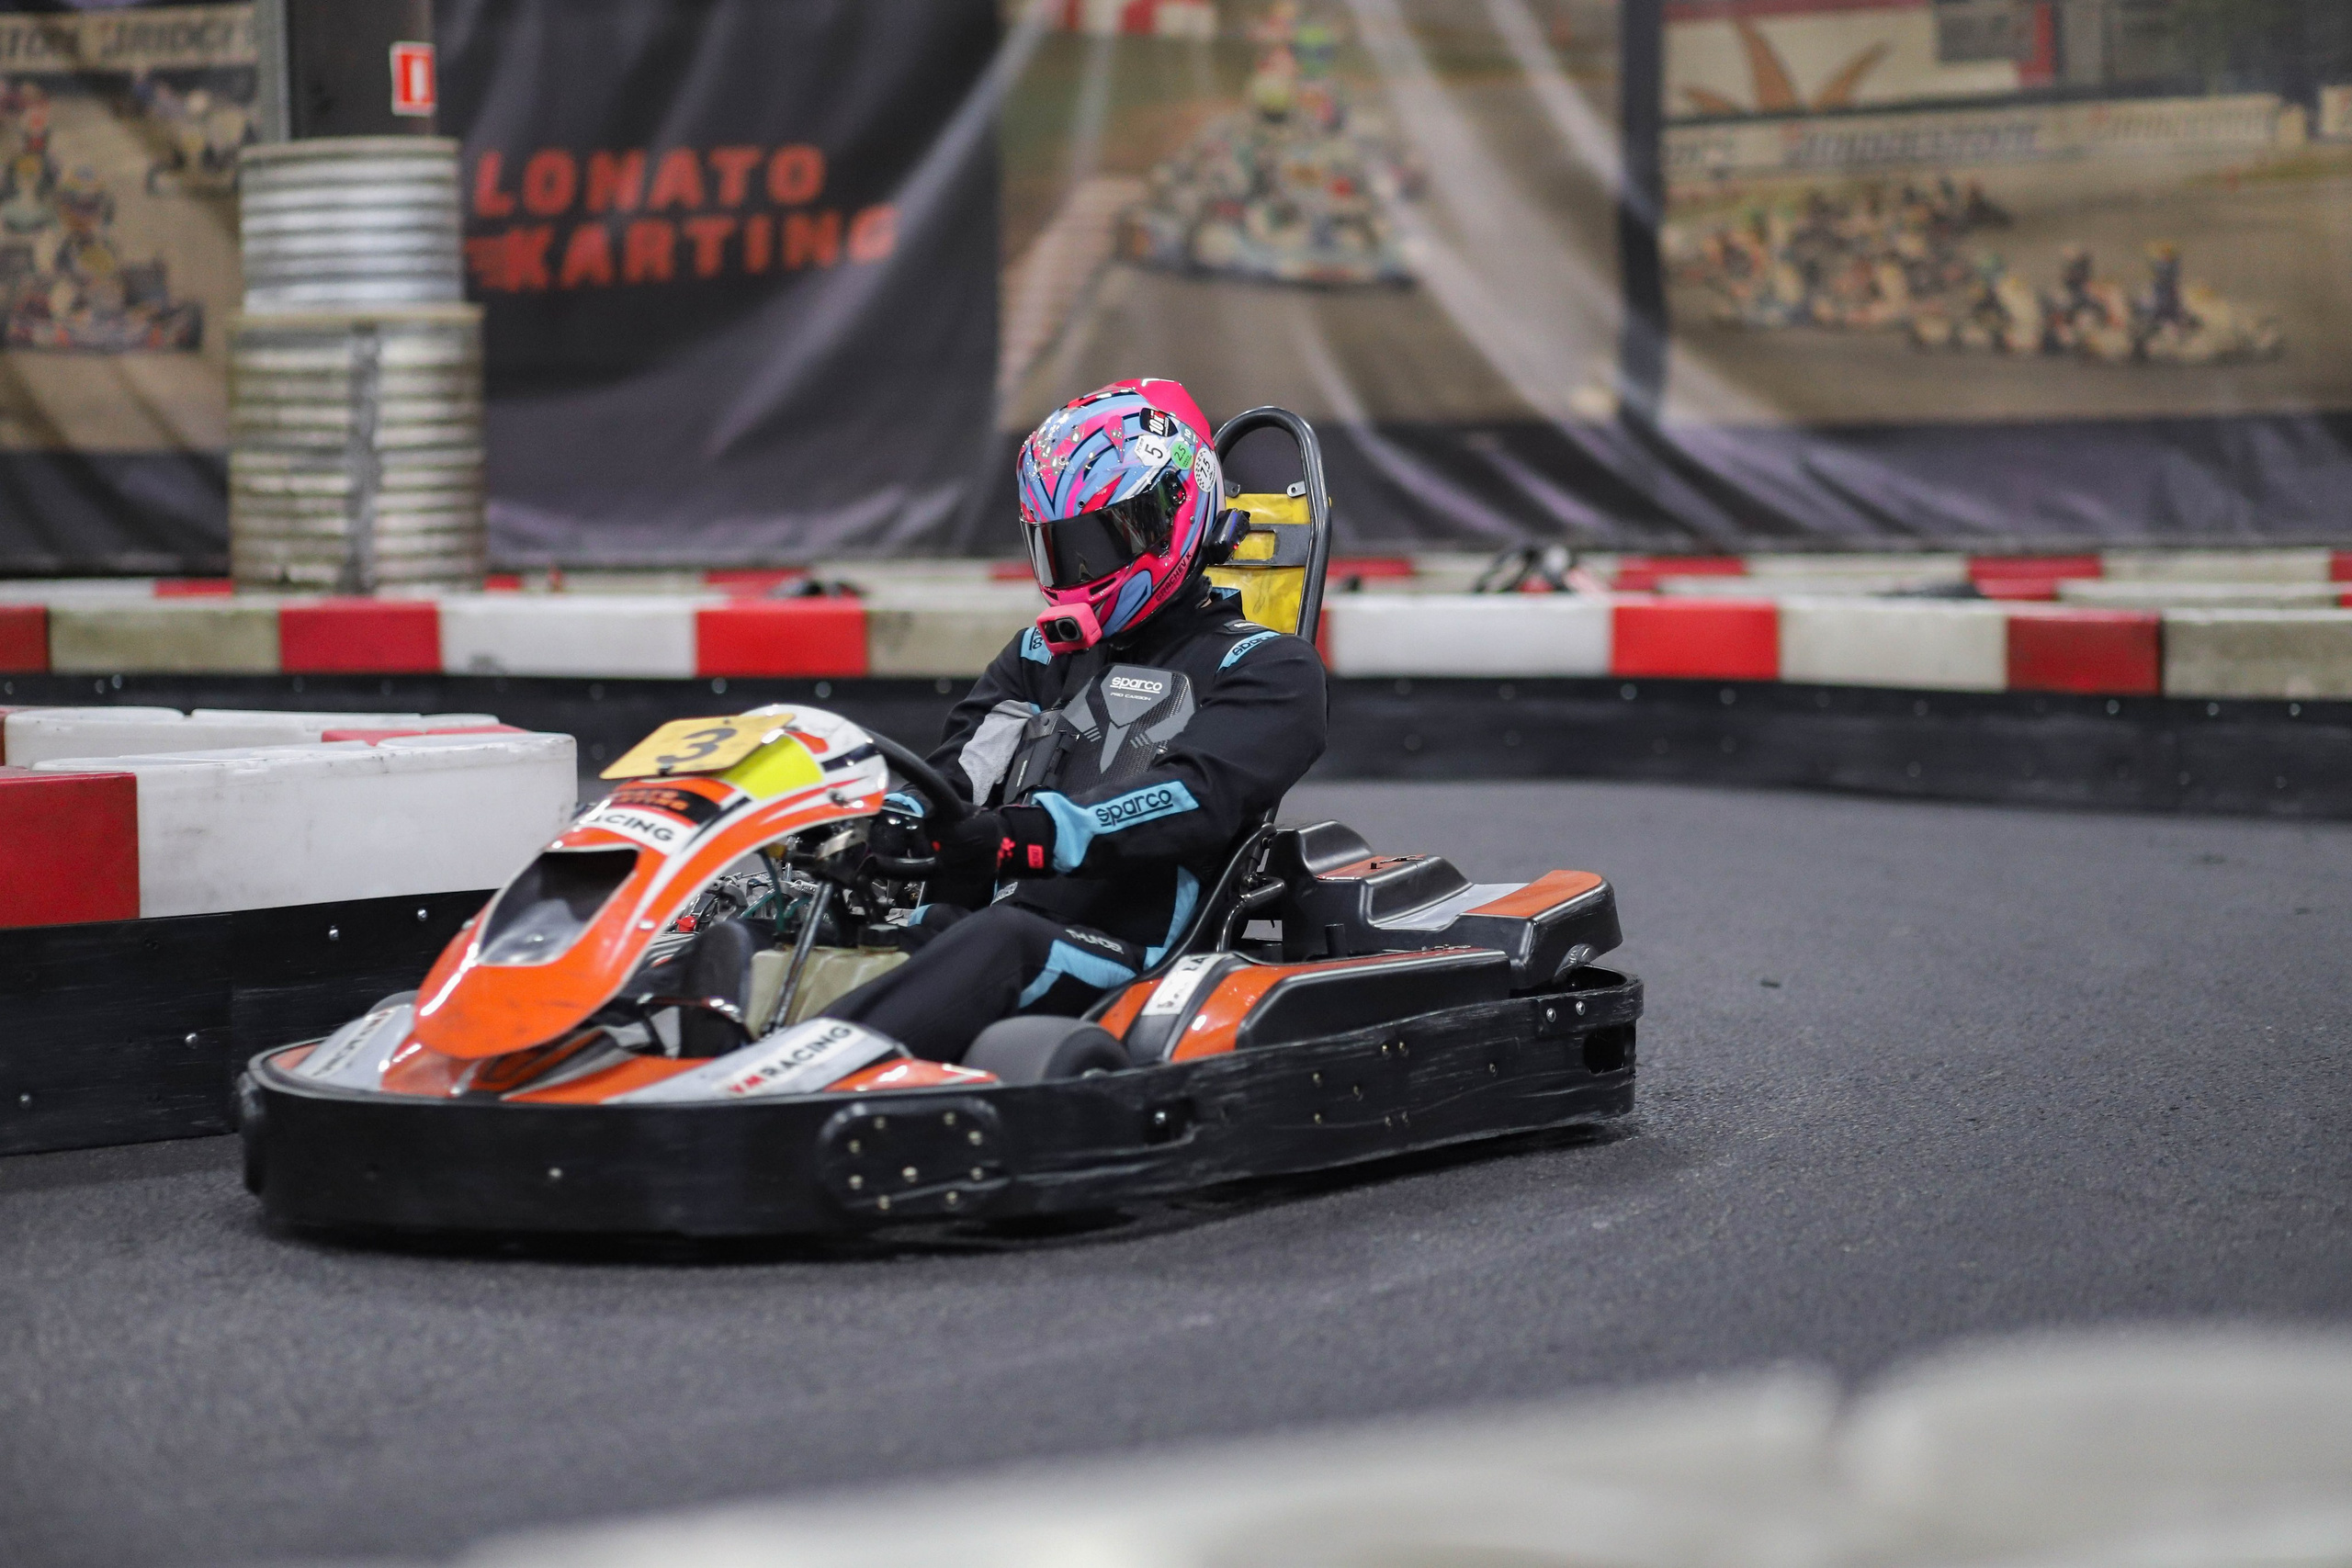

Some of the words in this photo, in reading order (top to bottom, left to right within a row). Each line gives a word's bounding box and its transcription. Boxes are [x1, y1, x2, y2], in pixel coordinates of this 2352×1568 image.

[466, 204, 899, 293] KARTING
[1144, 444, 1163, 459] 5
[1174, 445, 1186, 462] 2.5
[1200, 457, 1210, 479] 7.5
[1155, 561, 1189, 602] GRACHEV
[1110, 677, 1163, 694] sparco
[655, 728, 738, 764] 3
[1095, 789, 1174, 827] sparco
[759, 1025, 853, 1077] RACING
